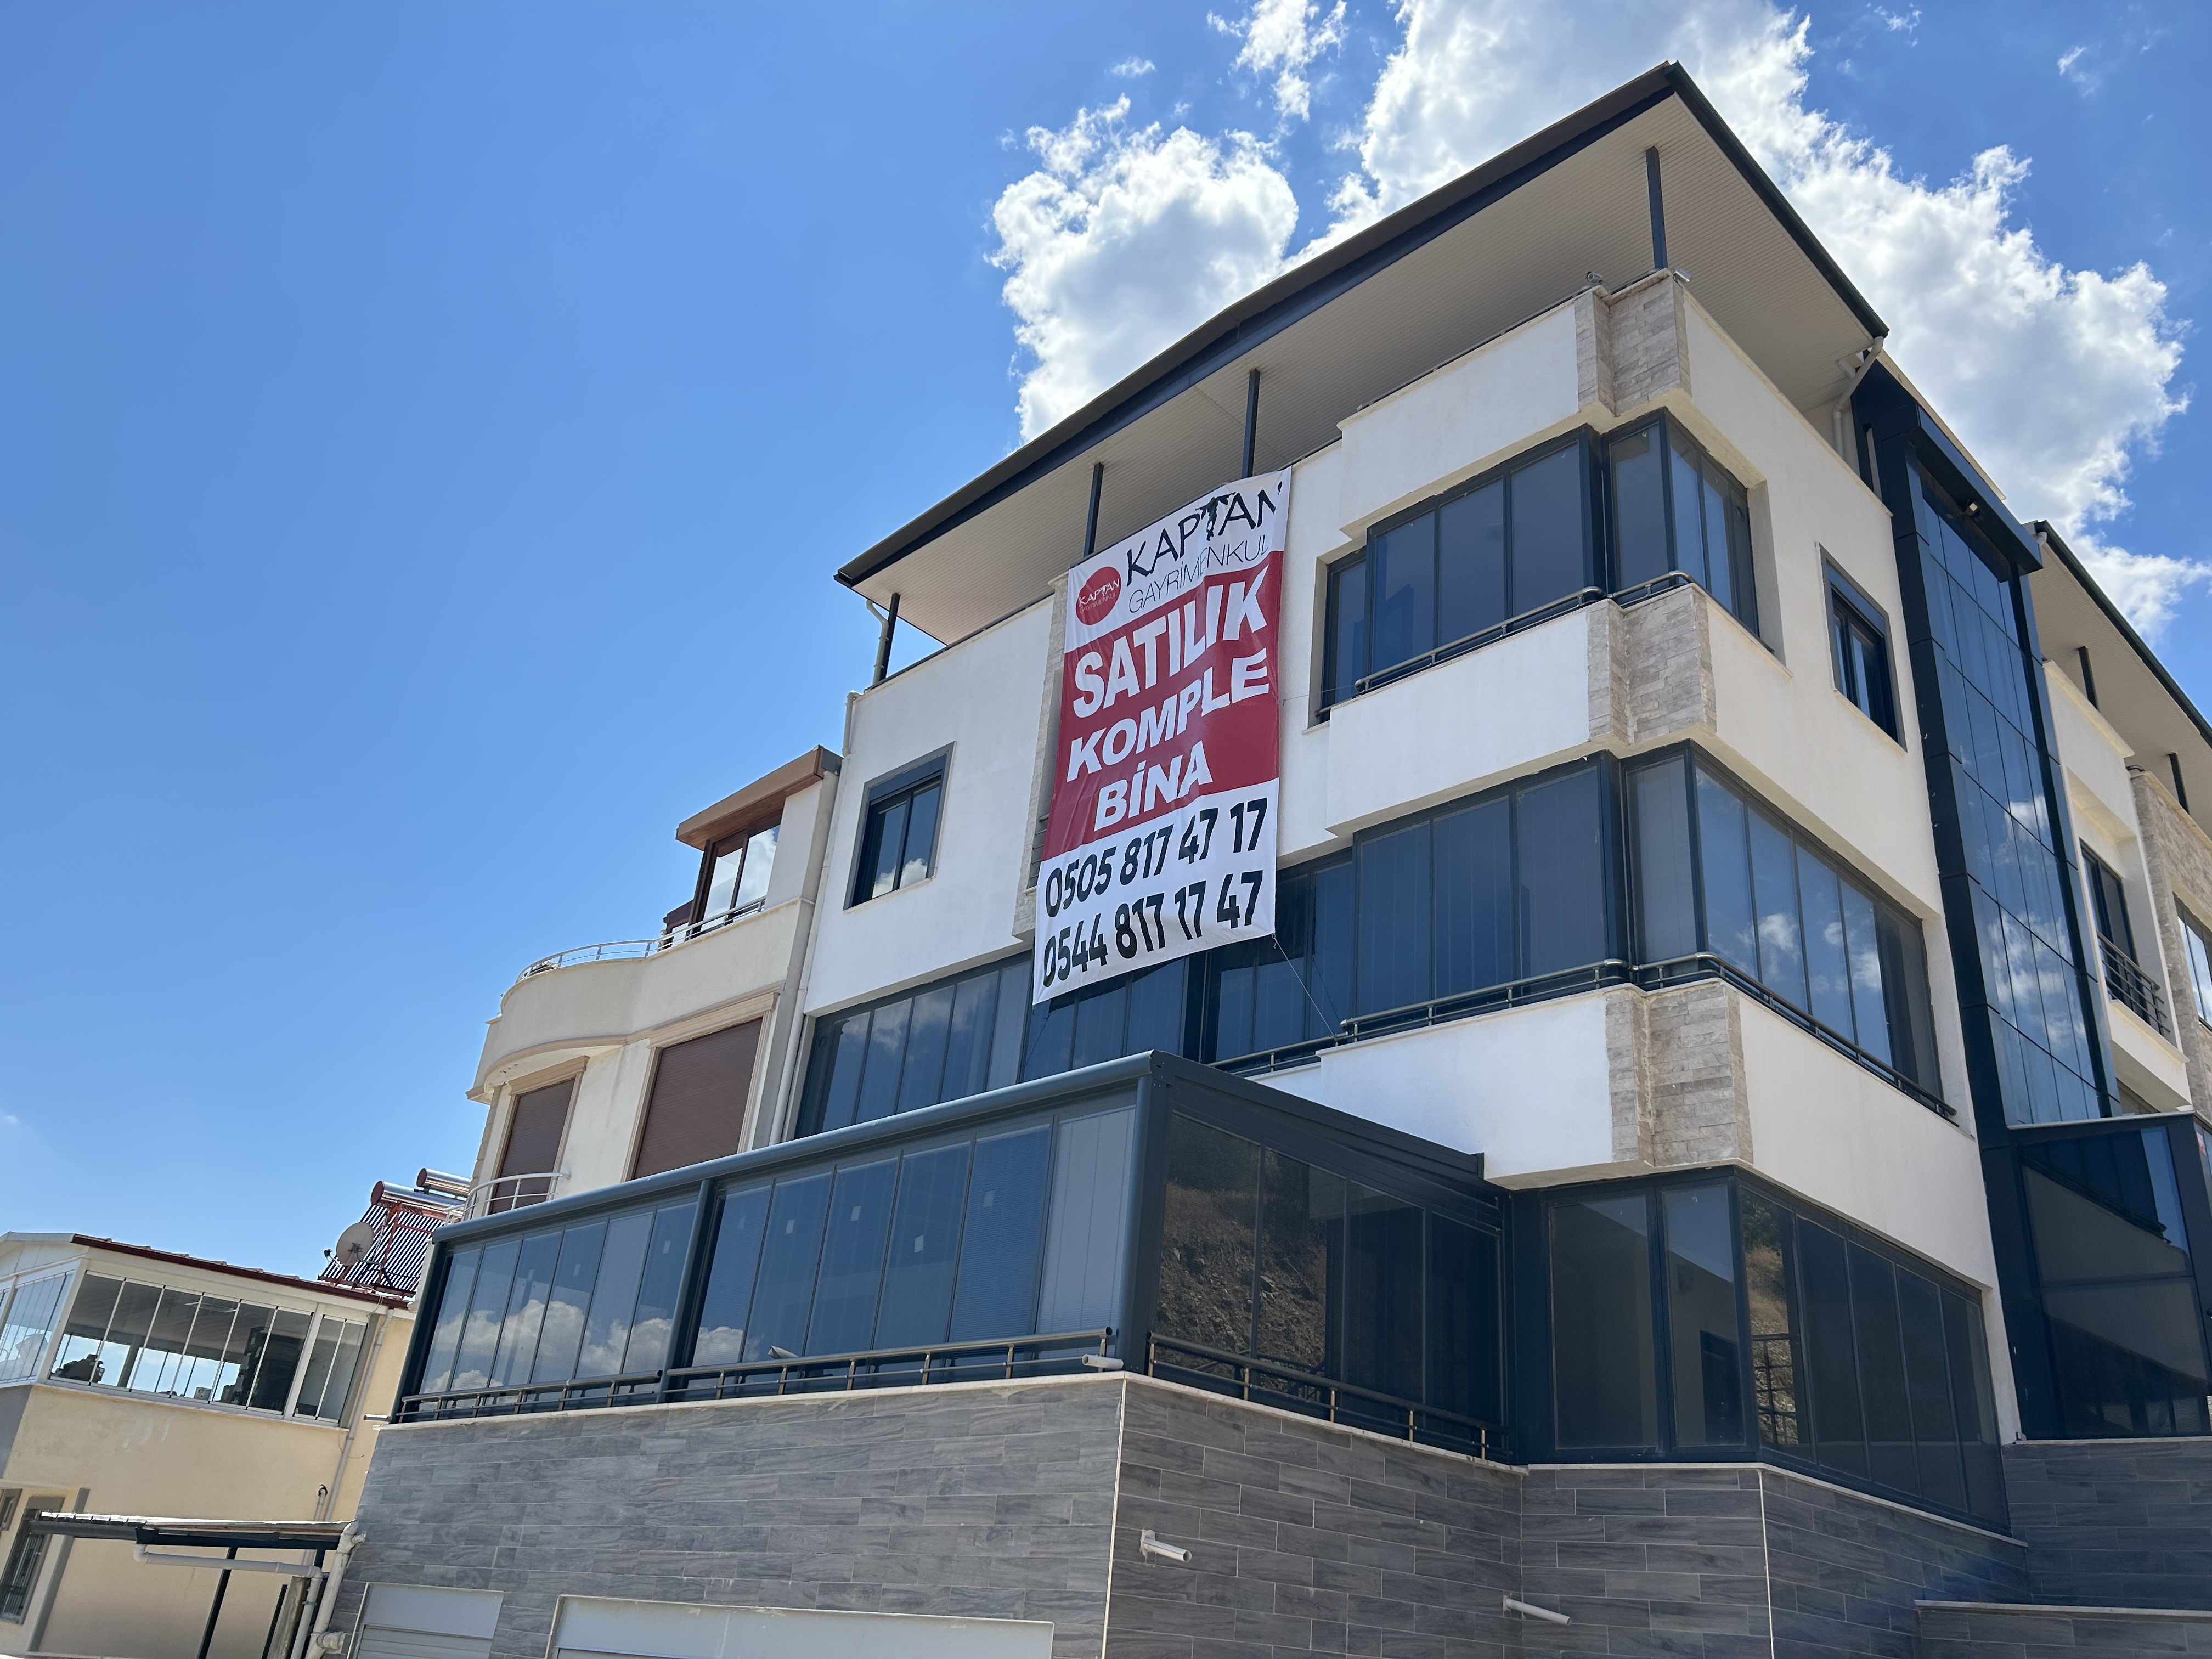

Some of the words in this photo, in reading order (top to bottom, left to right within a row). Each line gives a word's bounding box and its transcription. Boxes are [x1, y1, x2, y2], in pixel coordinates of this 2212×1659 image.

[1079, 578, 1120, 607] KAPTAN
[1126, 481, 1283, 587] KAPTAN
[1073, 565, 1269, 718] SATILIK
[1066, 647, 1269, 782] KOMPLE
[1094, 740, 1213, 832] BİNA
[1046, 845, 1117, 918] 0505
[1120, 824, 1175, 885] 817
[1178, 808, 1218, 864] 47
[1230, 797, 1268, 853] 17
[1043, 913, 1108, 988] 0544
[1115, 893, 1166, 959] 817
[1175, 881, 1206, 940] 17
[1217, 870, 1263, 929] 47
